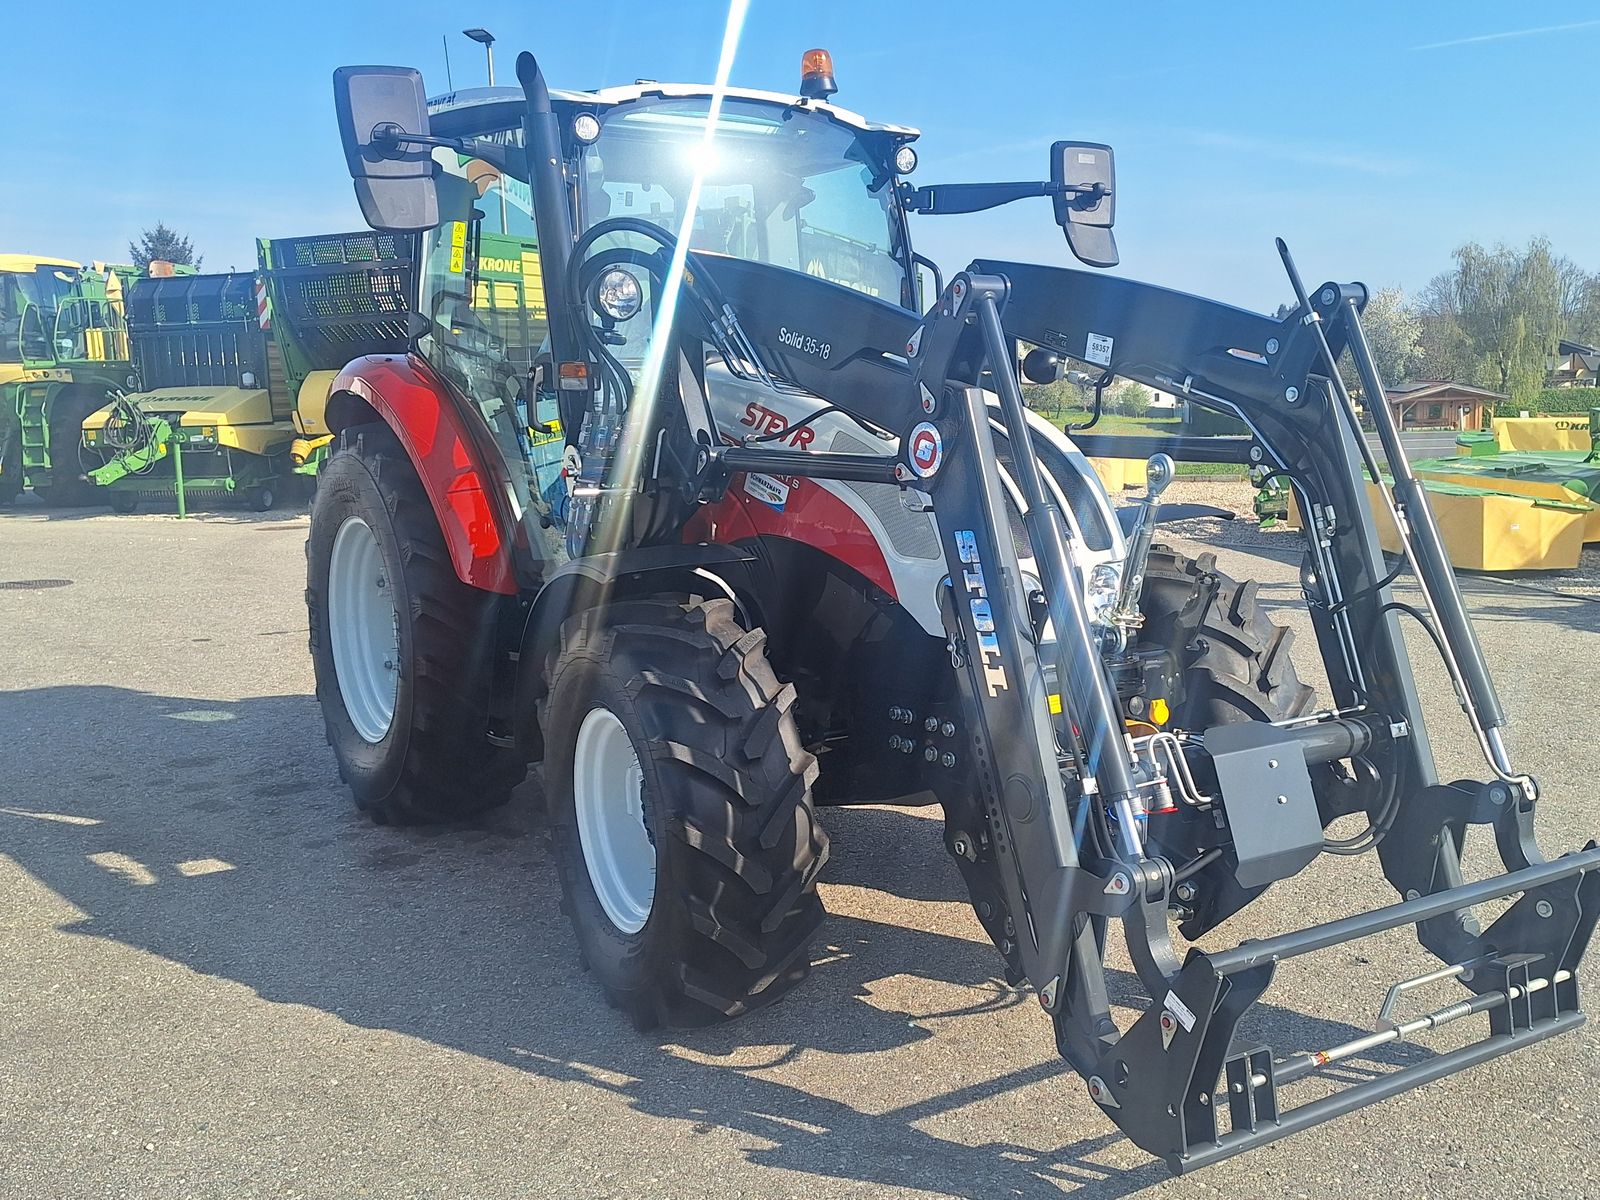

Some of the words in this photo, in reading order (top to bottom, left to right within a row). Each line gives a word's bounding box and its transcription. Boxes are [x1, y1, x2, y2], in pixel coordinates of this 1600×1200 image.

[479, 256, 521, 273] KRONE
[778, 327, 804, 350] Solid
[803, 337, 831, 360] 35-18
[1091, 342, 1110, 354] 58357
[954, 530, 1009, 697] STOLL
